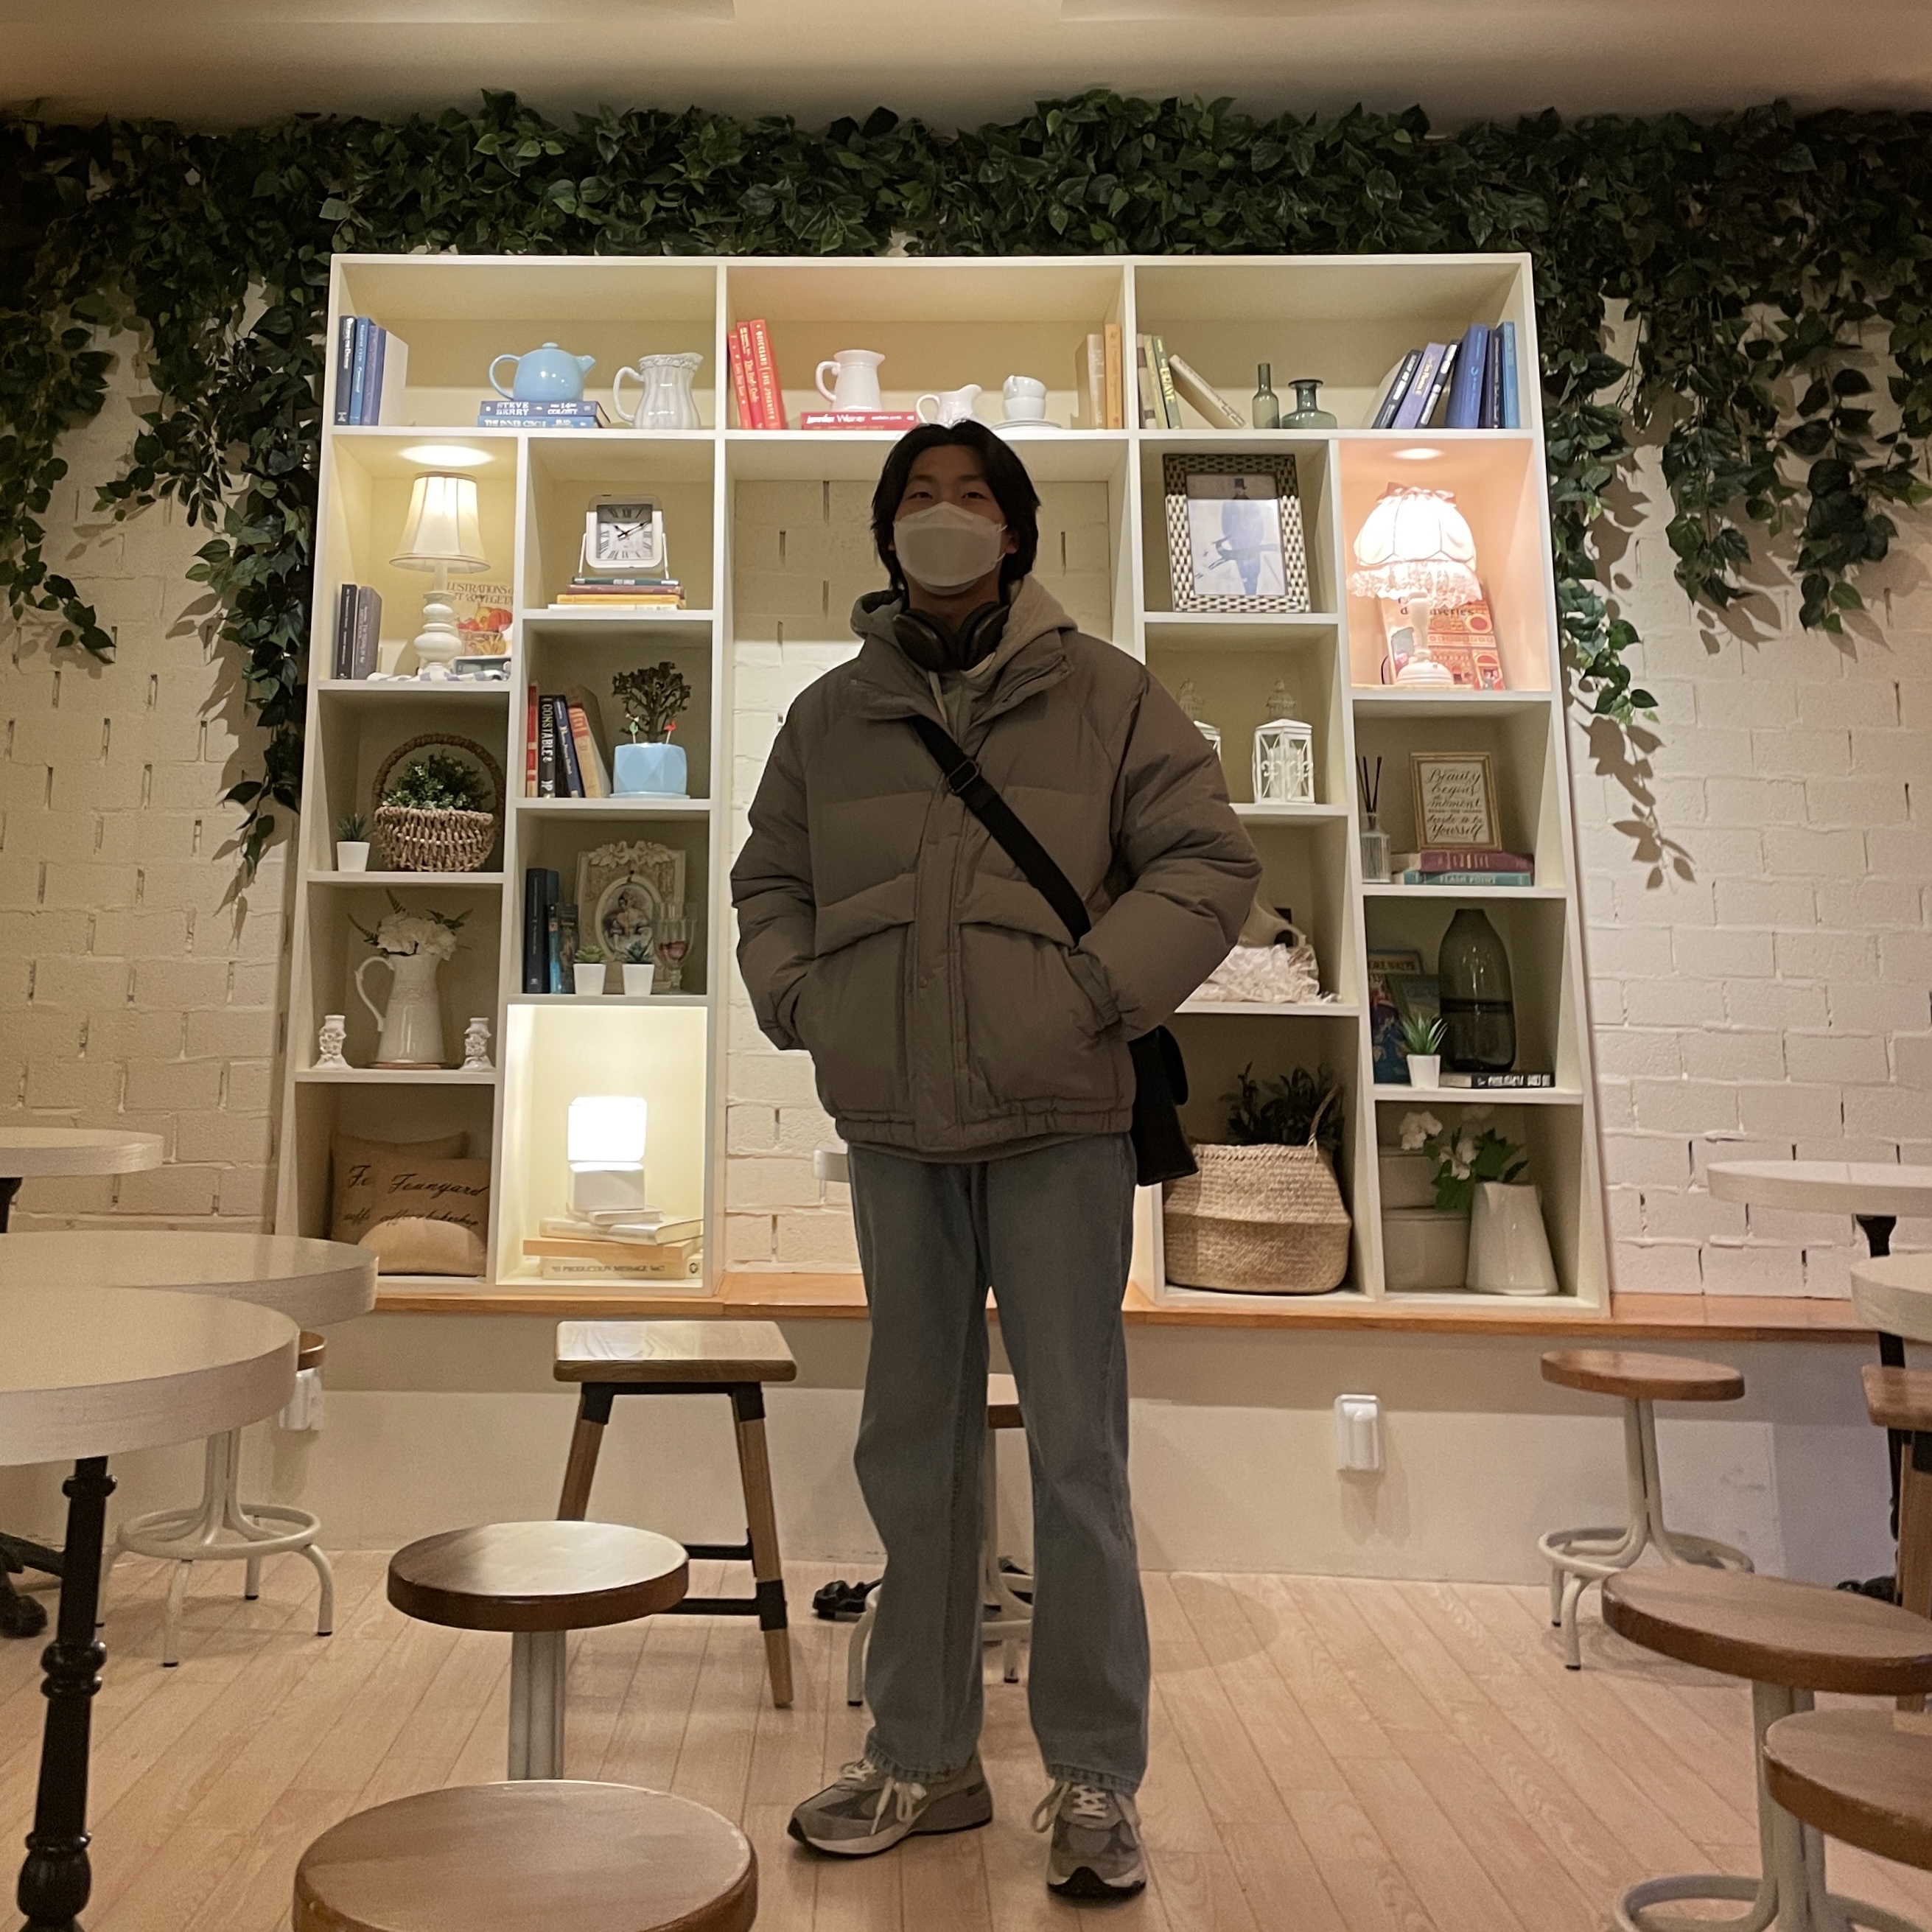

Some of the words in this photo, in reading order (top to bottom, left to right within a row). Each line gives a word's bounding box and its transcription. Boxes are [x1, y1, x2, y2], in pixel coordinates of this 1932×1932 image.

[541, 704, 553, 756] CONSTABLE
[1427, 769, 1481, 785] Beauty
[1440, 874, 1466, 883] FLASH
[1469, 875, 1497, 883] POINT
